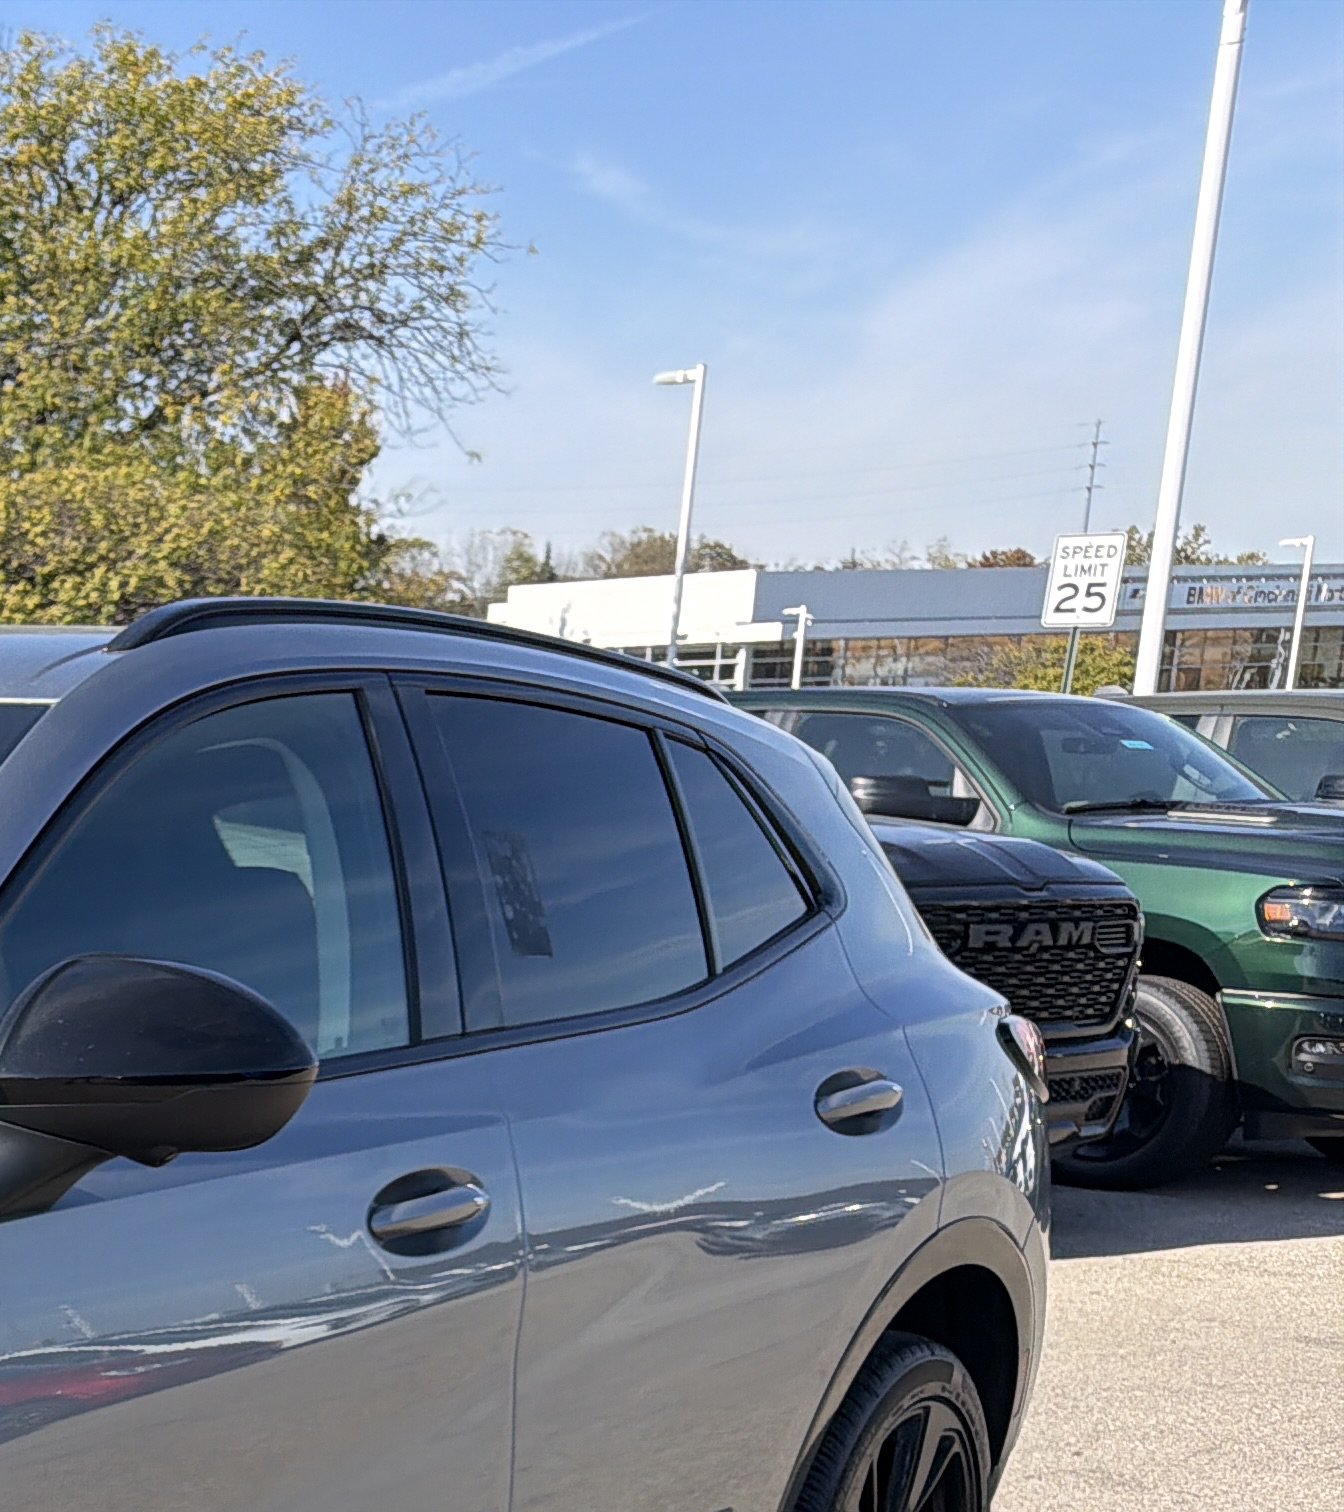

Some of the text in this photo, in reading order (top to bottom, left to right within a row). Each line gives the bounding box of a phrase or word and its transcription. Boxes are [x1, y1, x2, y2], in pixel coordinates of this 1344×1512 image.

[1060, 545, 1118, 559] SPEED
[1063, 563, 1109, 577] LIMIT
[1053, 582, 1108, 614] 25
[968, 921, 1095, 948] RAM
